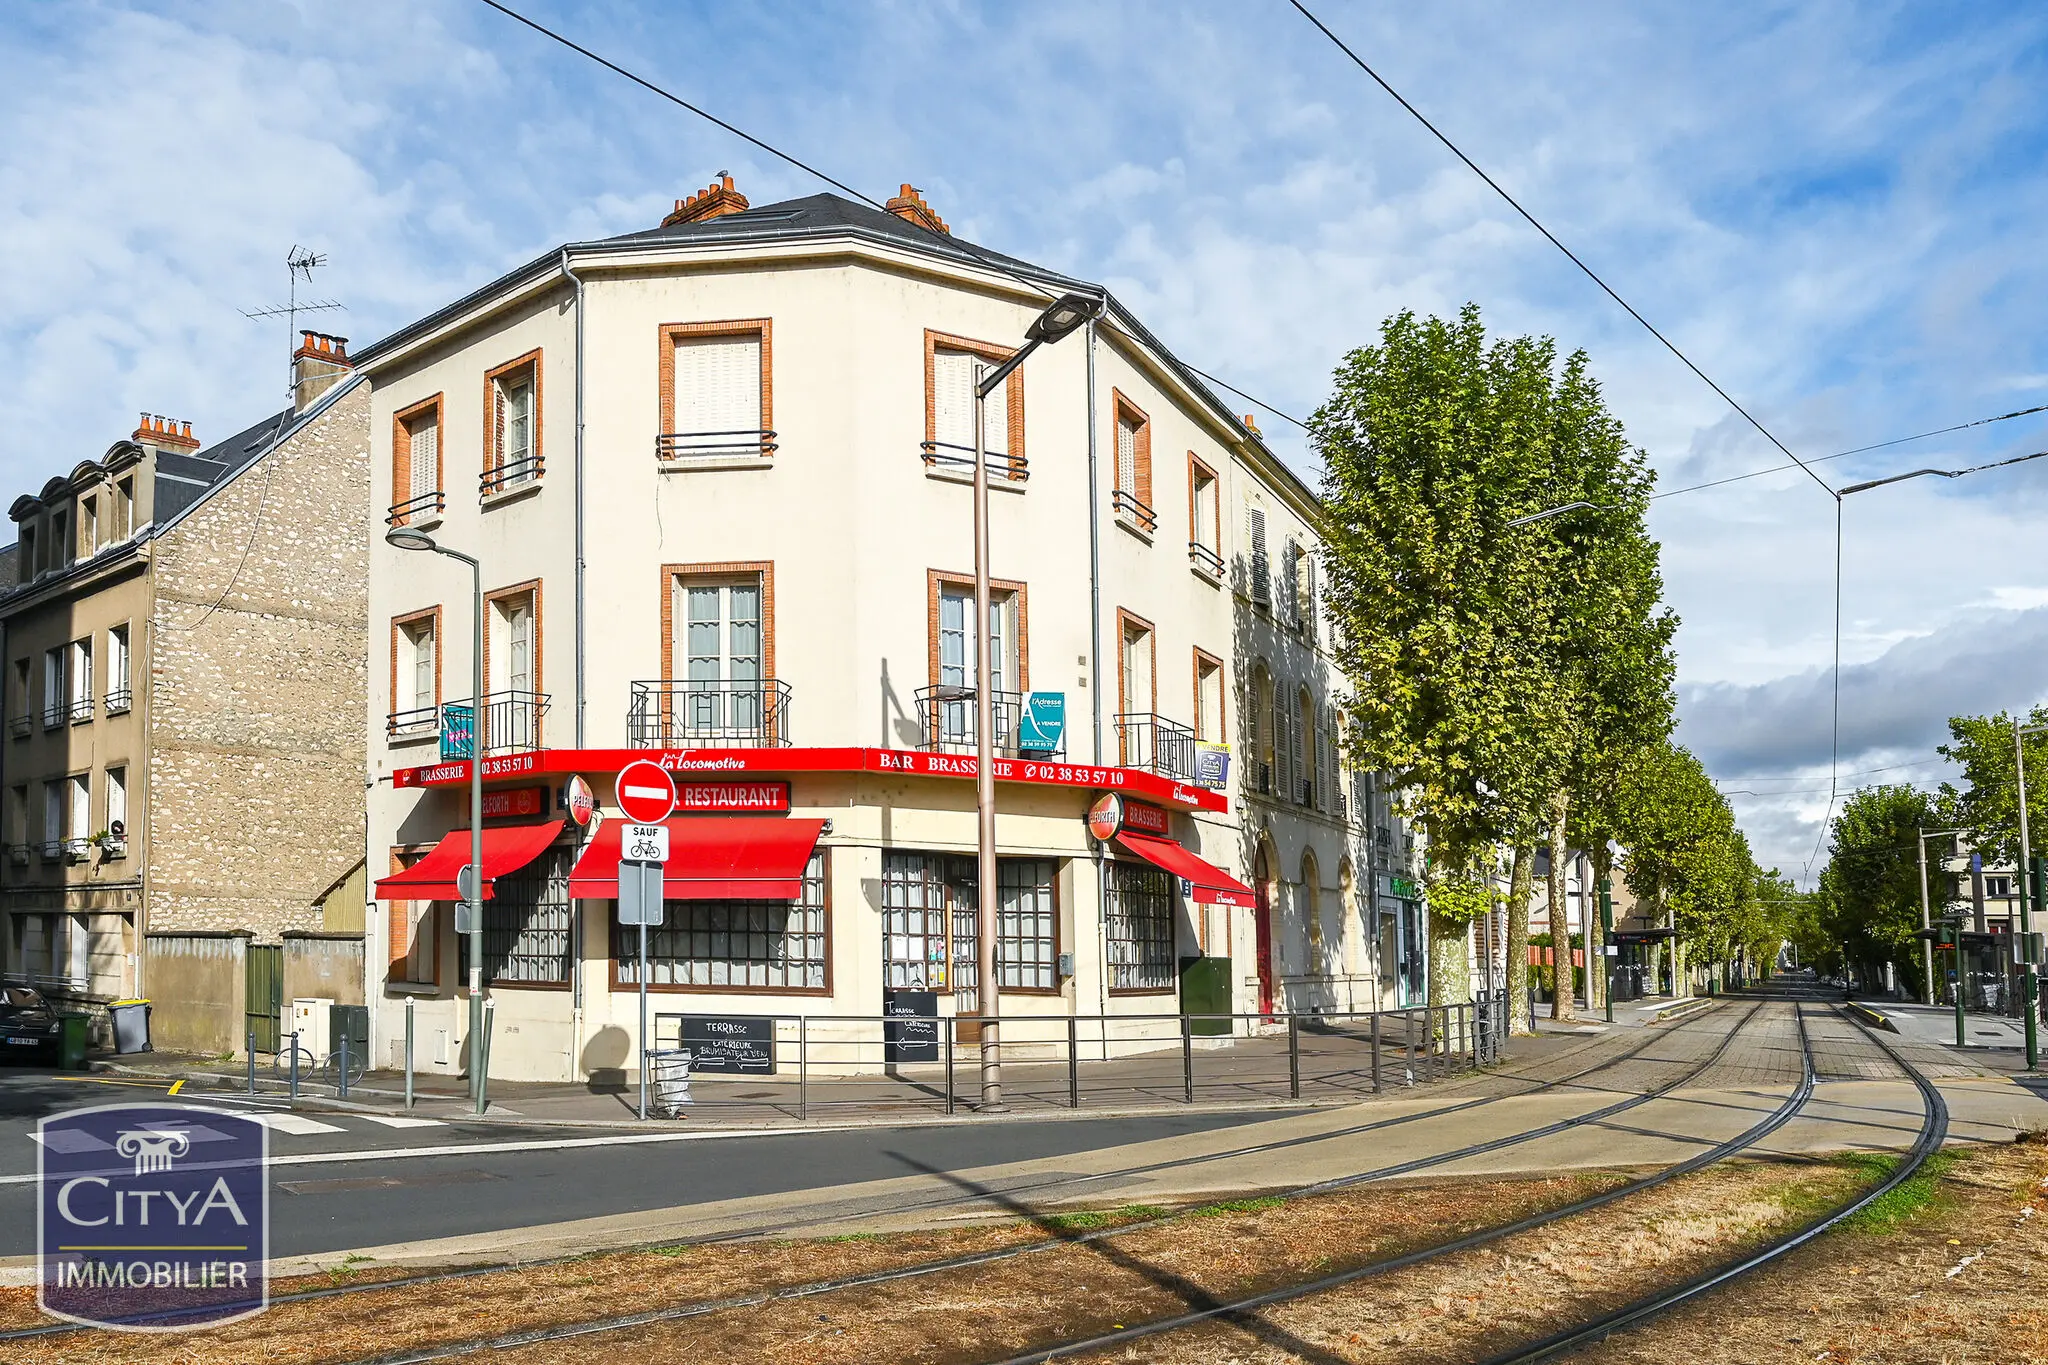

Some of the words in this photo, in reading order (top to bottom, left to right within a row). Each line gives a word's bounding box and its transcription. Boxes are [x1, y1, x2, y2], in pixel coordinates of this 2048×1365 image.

[420, 766, 464, 781] BRASSERIE
[481, 762, 490, 774] 02
[492, 760, 501, 773] 38
[502, 759, 511, 772] 53
[513, 758, 522, 770] 57
[523, 756, 533, 769] 10
[879, 753, 914, 769] BAR
[1040, 765, 1055, 779] 02
[1058, 767, 1072, 780] 38
[1075, 769, 1089, 782] 53
[1092, 771, 1107, 784] 57
[1110, 772, 1124, 785] 10
[685, 787, 780, 806] RESTAURANT
[1129, 806, 1162, 829] BRASSERIE
[633, 826, 658, 836] SAUF
[706, 1022, 747, 1034] TERRASSE
